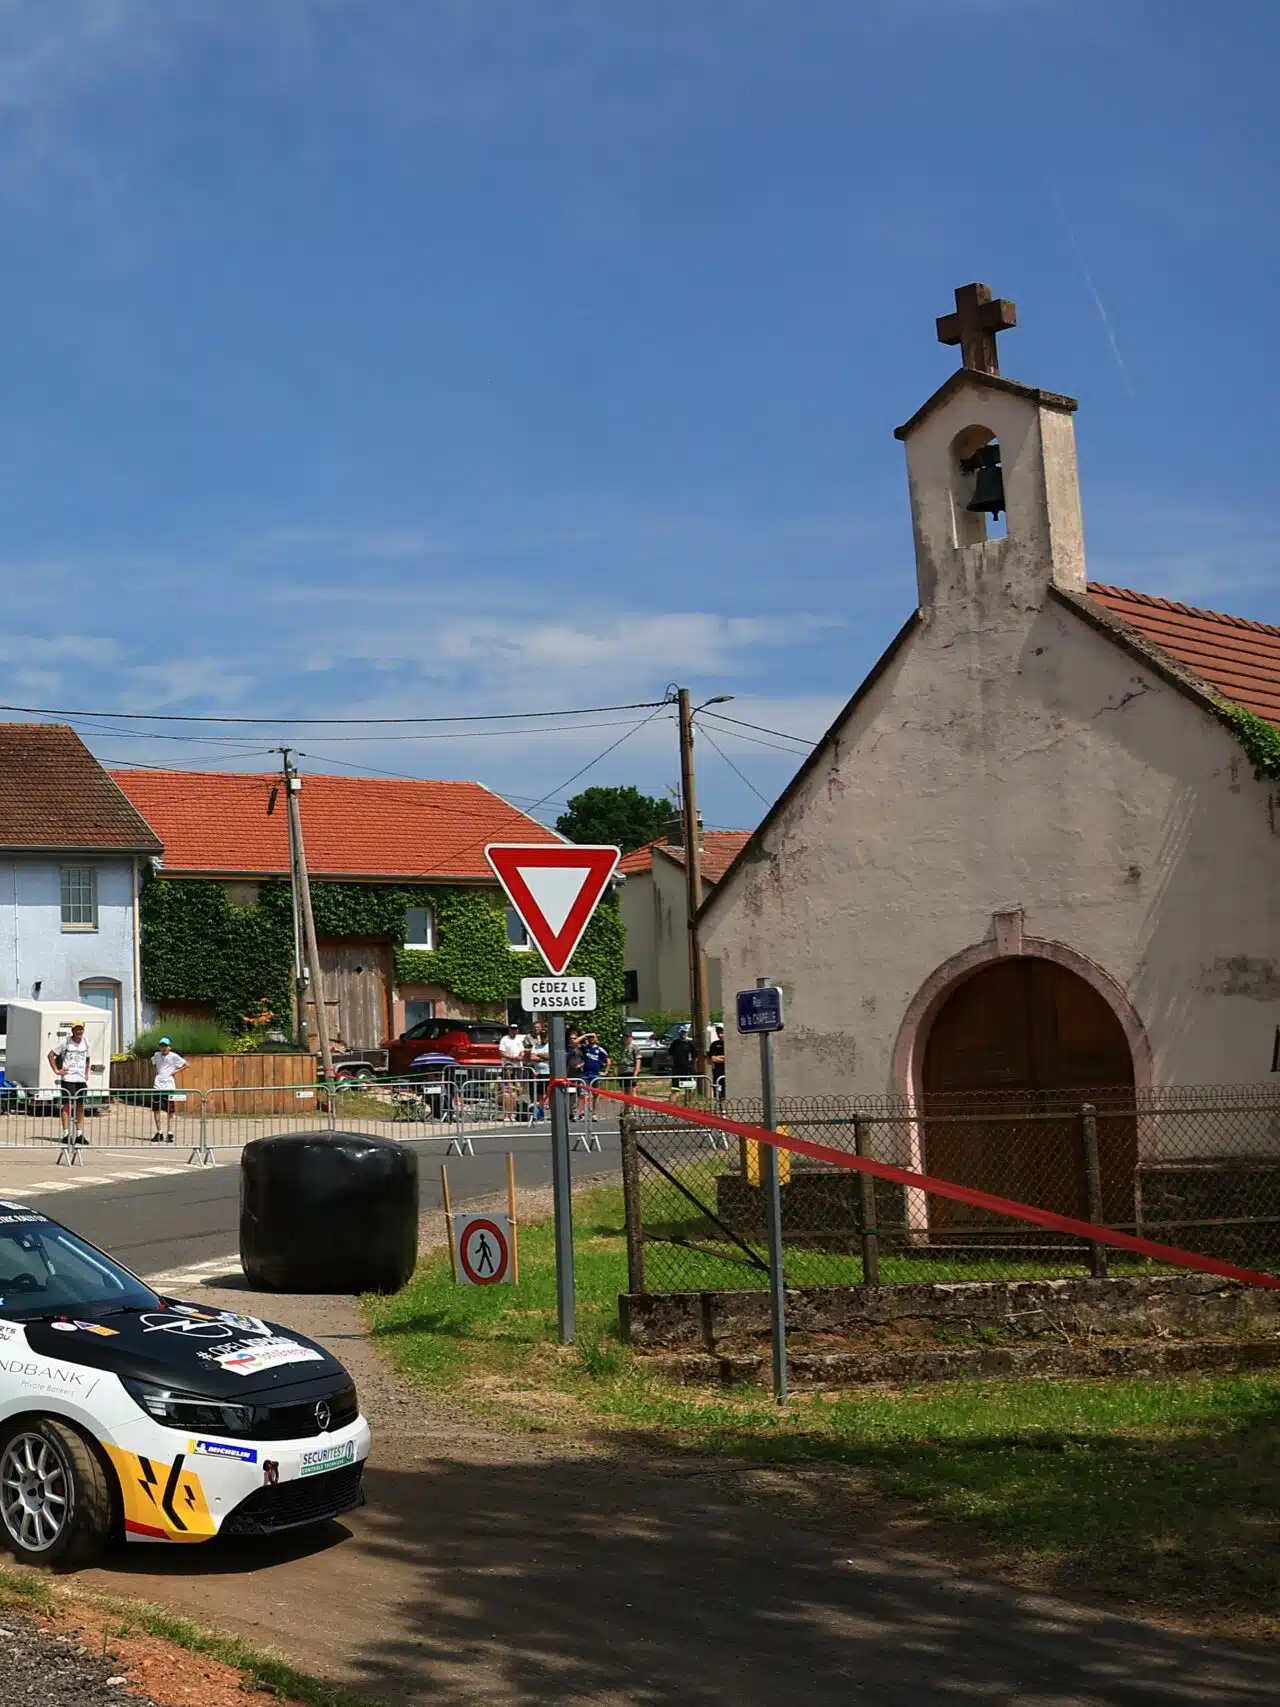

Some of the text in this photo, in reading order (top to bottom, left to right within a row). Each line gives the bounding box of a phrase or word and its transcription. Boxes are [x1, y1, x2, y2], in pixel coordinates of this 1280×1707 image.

[532, 981, 586, 993] CÉDEZ LE
[533, 996, 586, 1007] PASSAGE
[207, 1446, 251, 1459] MICHELIN
